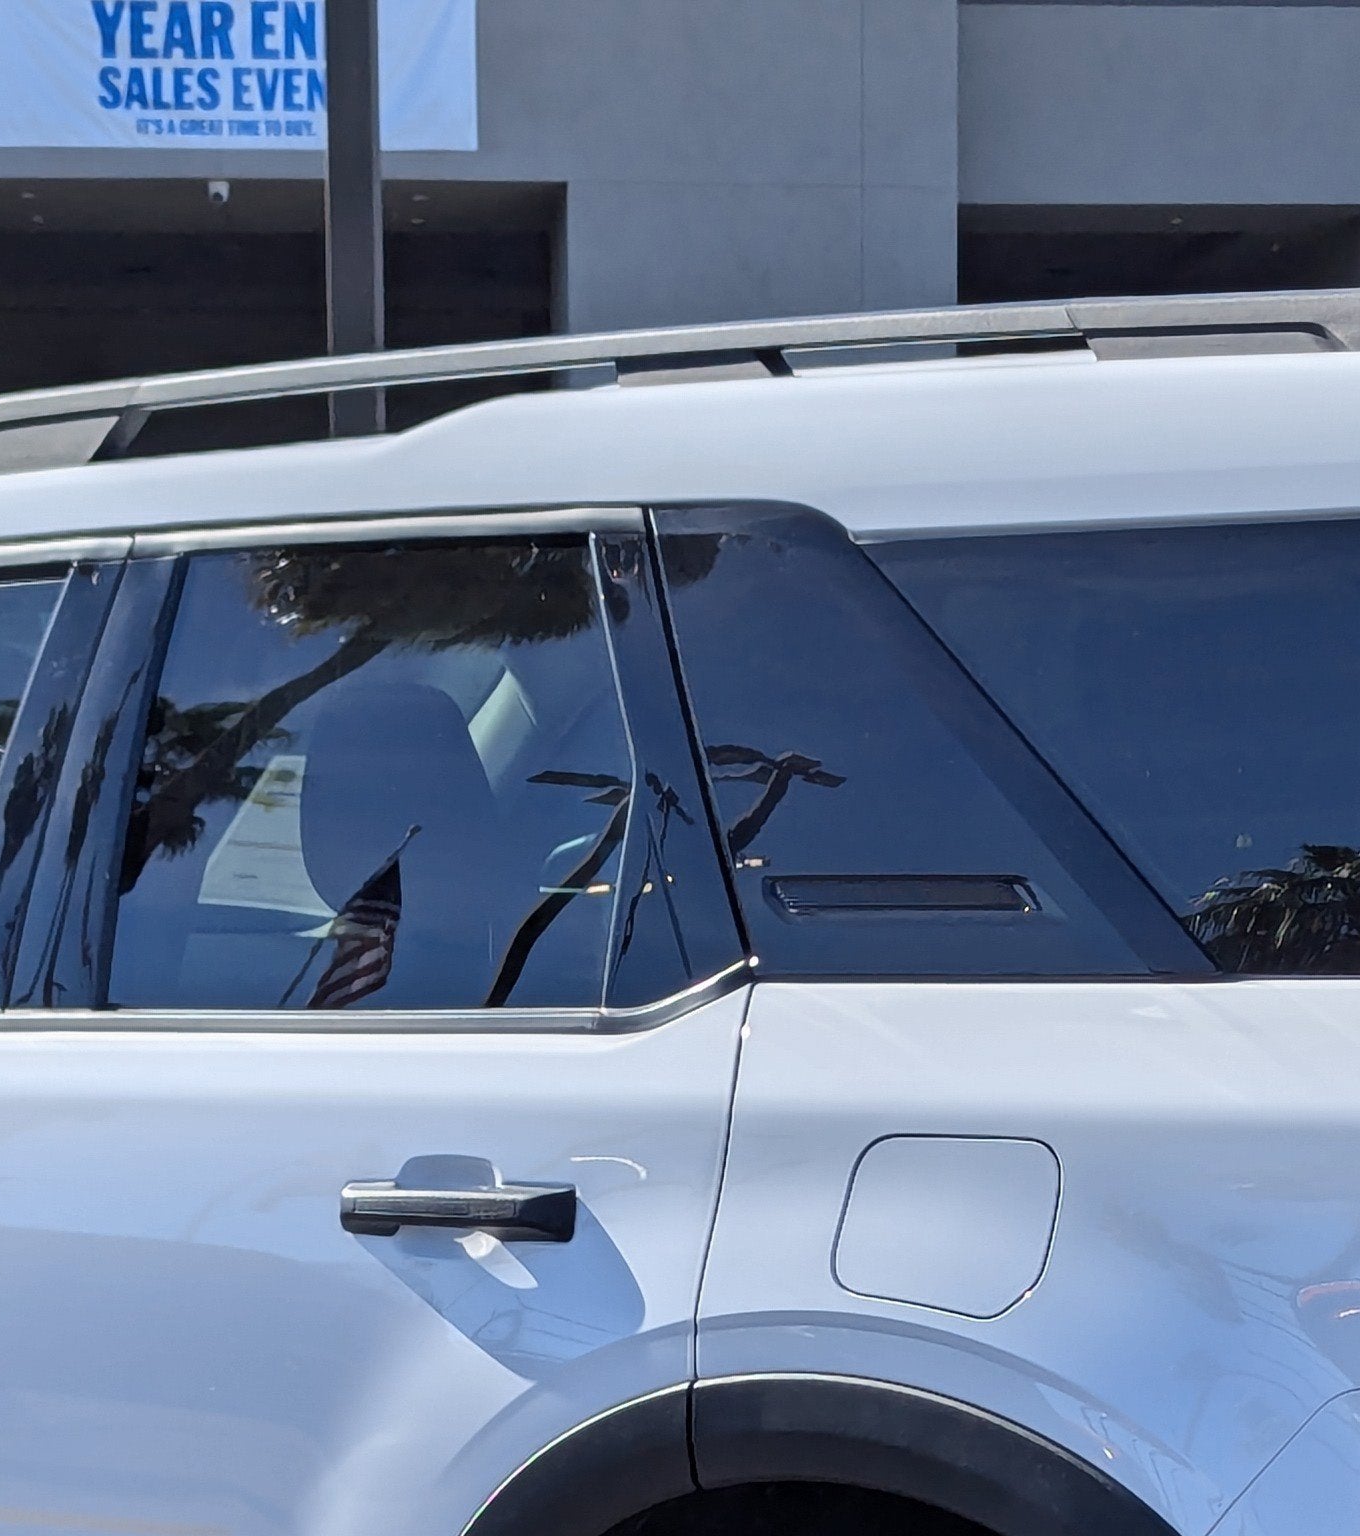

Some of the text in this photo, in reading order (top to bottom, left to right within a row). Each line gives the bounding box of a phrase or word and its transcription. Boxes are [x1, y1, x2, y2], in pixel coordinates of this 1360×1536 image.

[91, 0, 318, 60] YEAR EN
[98, 65, 326, 112] SALES EVEN
[136, 118, 164, 136] IT'S
